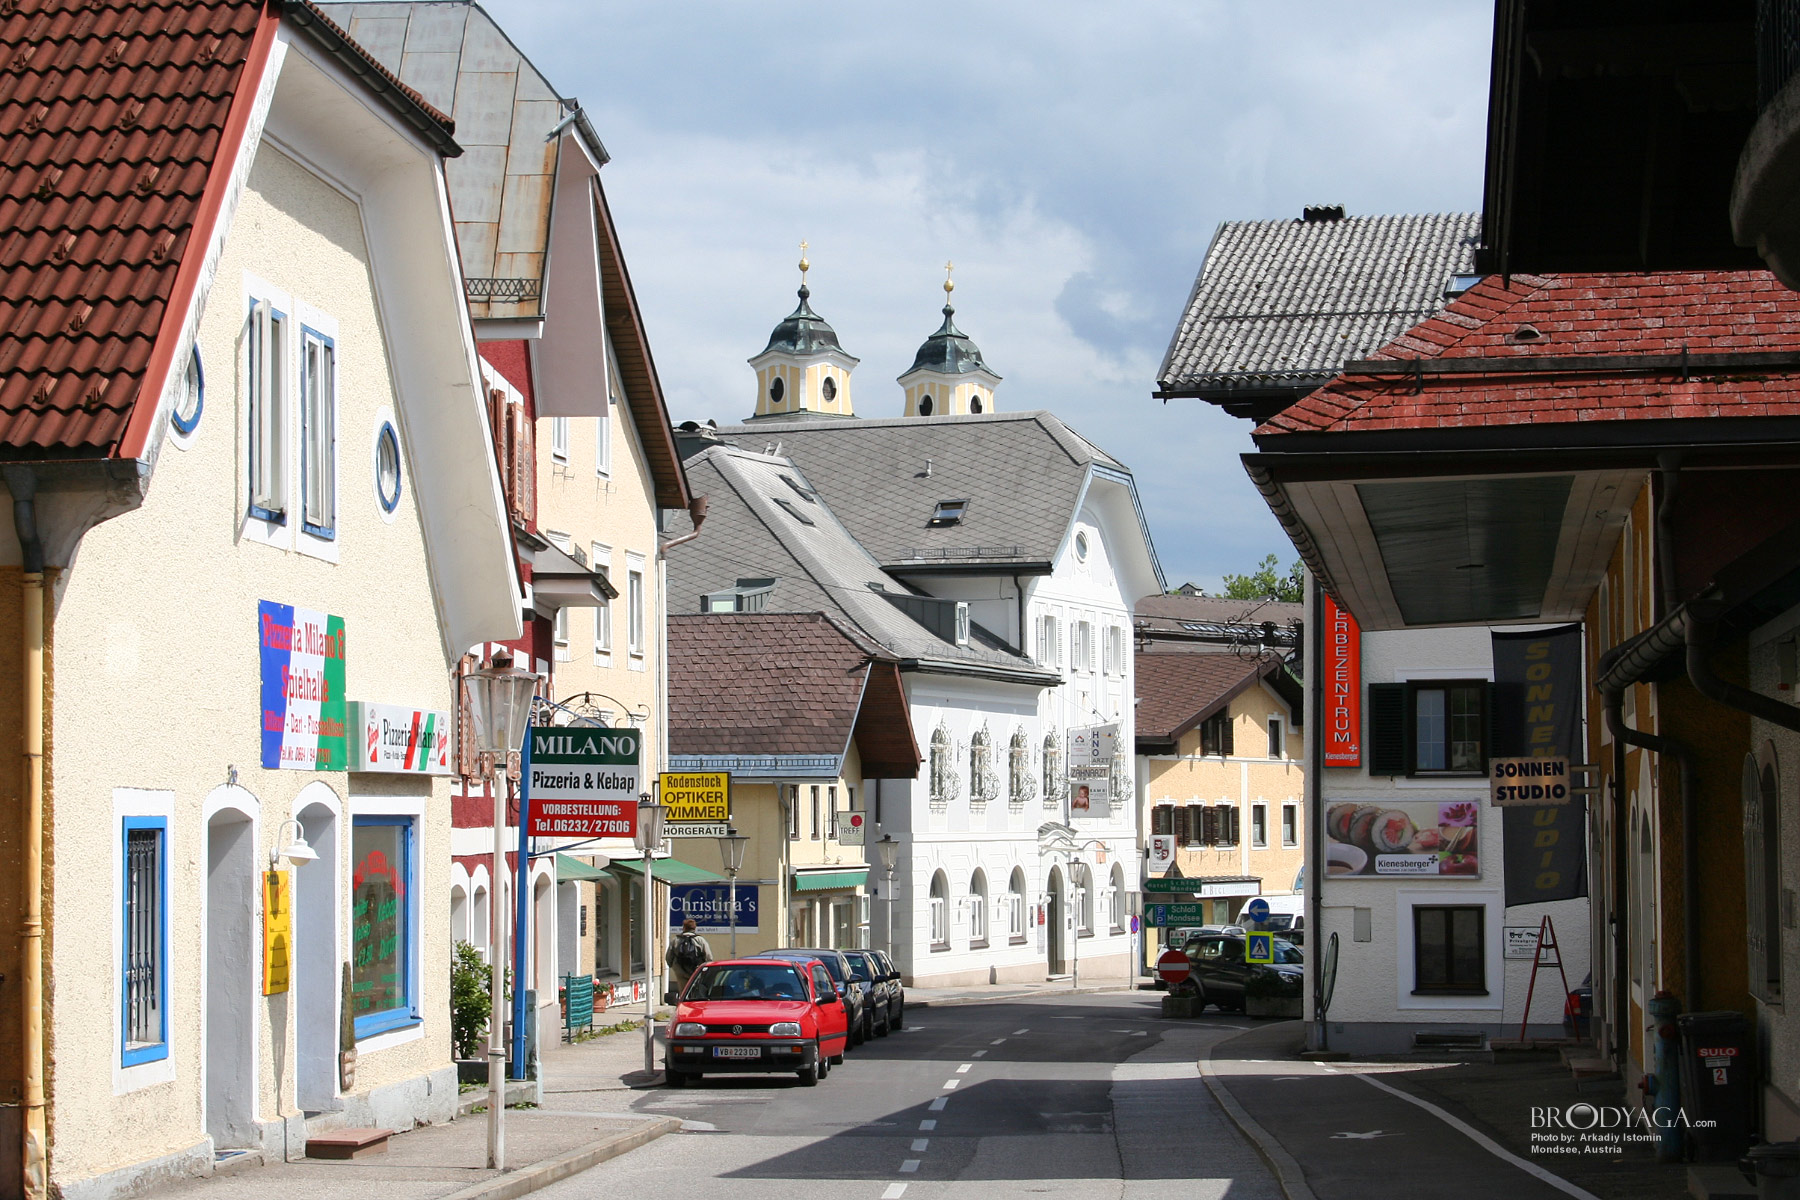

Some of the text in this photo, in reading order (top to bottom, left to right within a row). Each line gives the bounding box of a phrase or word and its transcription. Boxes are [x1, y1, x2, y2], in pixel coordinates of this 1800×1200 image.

[262, 613, 344, 660] Pizzeria Milano &
[1334, 604, 1350, 742] ERBEZENTRUM
[281, 664, 328, 706] Spielhalle
[383, 718, 411, 746] Pizzeria
[534, 735, 636, 756] MILANO
[1071, 769, 1107, 778] ZAHNARZT
[1495, 761, 1564, 778] SONNEN
[532, 771, 634, 793] Pizzeria & Kebap
[667, 775, 721, 788] Rodenstock
[664, 791, 723, 803] OPTIKER
[1496, 784, 1566, 801] STUDIO
[542, 803, 622, 816] VORBESTELLUNG:
[666, 806, 725, 818] WIMMER
[535, 818, 630, 833] Tel.06232/27606
[663, 825, 725, 835] HÖRGERÄTE
[1378, 860, 1430, 869] Kienesberger
[1171, 905, 1196, 913] Schloß
[720, 1048, 729, 1056] VB
[734, 1048, 748, 1056] 223
[1700, 1048, 1736, 1056] SULO
[1715, 1069, 1724, 1081] 2
